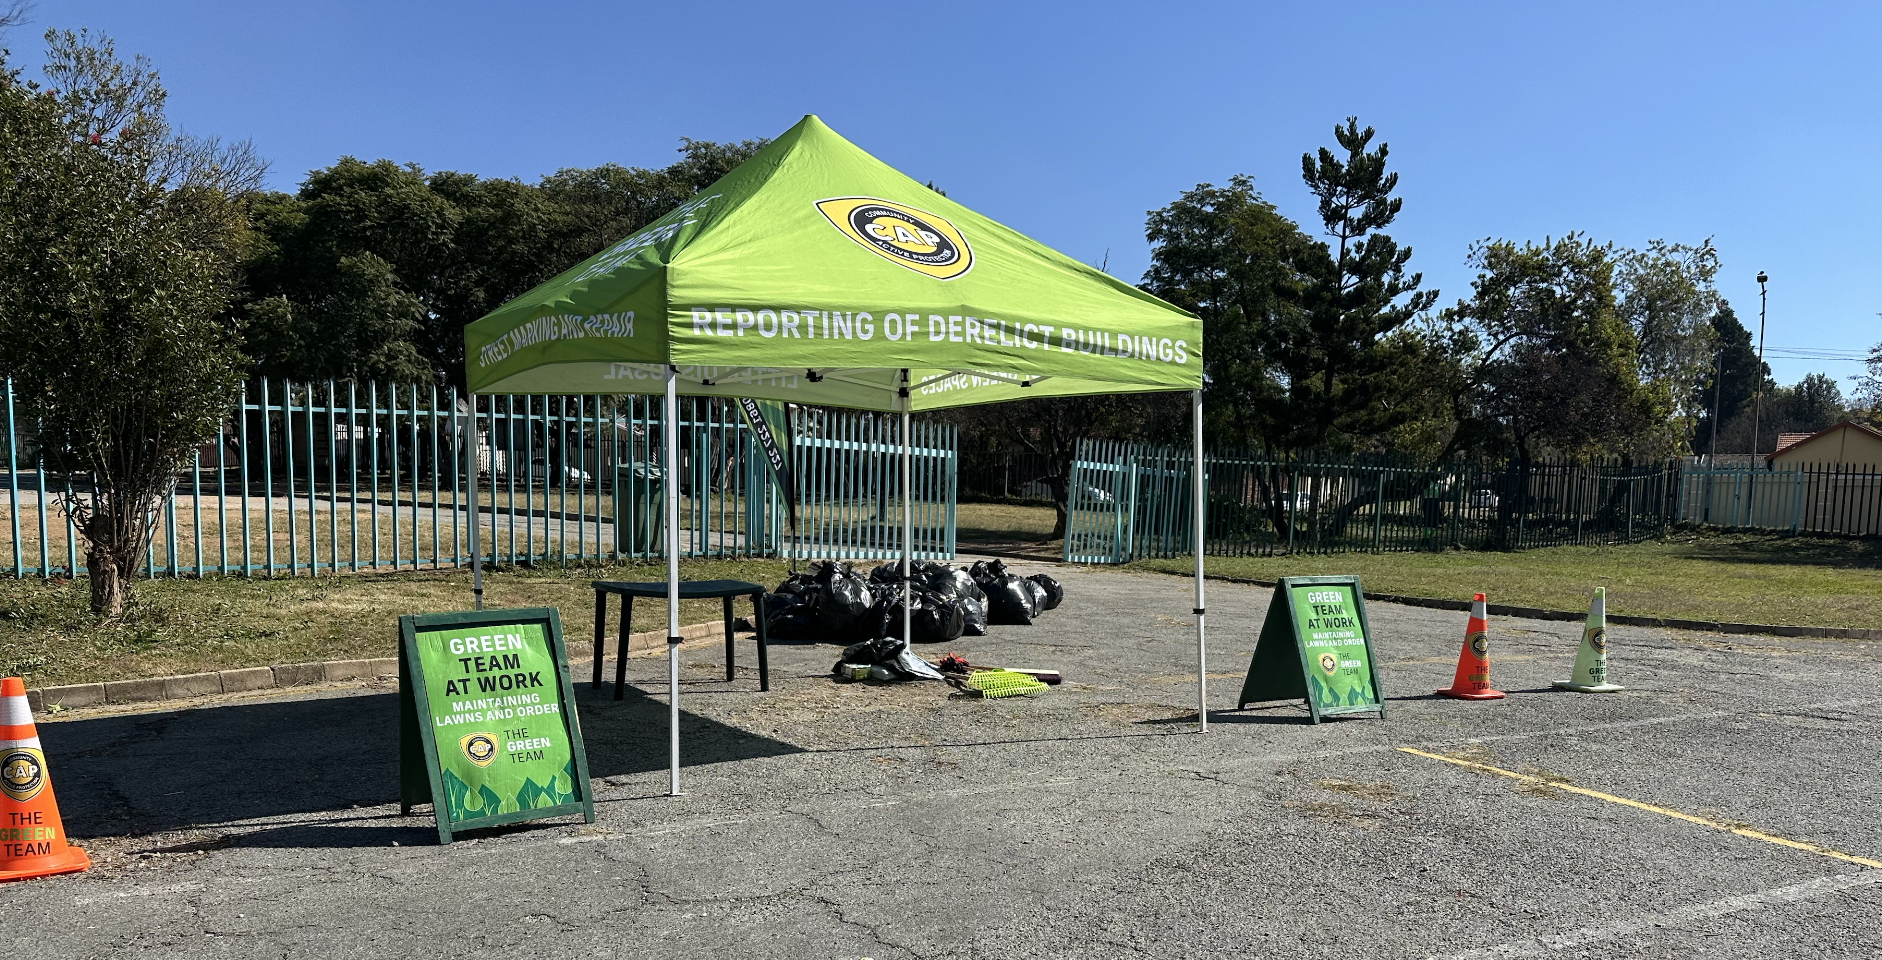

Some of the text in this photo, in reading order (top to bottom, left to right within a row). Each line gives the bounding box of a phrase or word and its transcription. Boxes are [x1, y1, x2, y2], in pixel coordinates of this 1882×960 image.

[864, 210, 915, 224] COMMUNITY
[864, 223, 941, 247] CAP
[875, 240, 910, 257] ACTIVE
[479, 311, 635, 368] STREET MARKING AND REPAIR
[691, 307, 1188, 364] REPORTING OF DERELICT BUILDINGS
[1308, 592, 1343, 604] GREEN
[1312, 604, 1344, 616] TEAM
[1308, 617, 1356, 630] AT WORK
[1305, 638, 1365, 648] LAWNS AND ORDER
[1312, 632, 1355, 640] MAINTAINING
[450, 633, 522, 655] GREEN
[1338, 652, 1352, 660] THE
[459, 654, 521, 674] TEAM
[1340, 660, 1362, 668] GREEN
[1475, 666, 1488, 674] THE
[1342, 668, 1359, 676] TEAM
[445, 671, 544, 697] AT WORK
[452, 693, 540, 713] MAINTAINING
[436, 703, 560, 727] LAWNS AND ORDER
[504, 728, 530, 740] THE
[470, 743, 492, 753] CAP
[507, 737, 551, 752] GREEN
[509, 750, 544, 764] TEAM
[3, 765, 38, 779] CAP
[8, 812, 43, 825] THE
[0, 826, 56, 841] GREEN
[4, 842, 52, 857] TEAM
